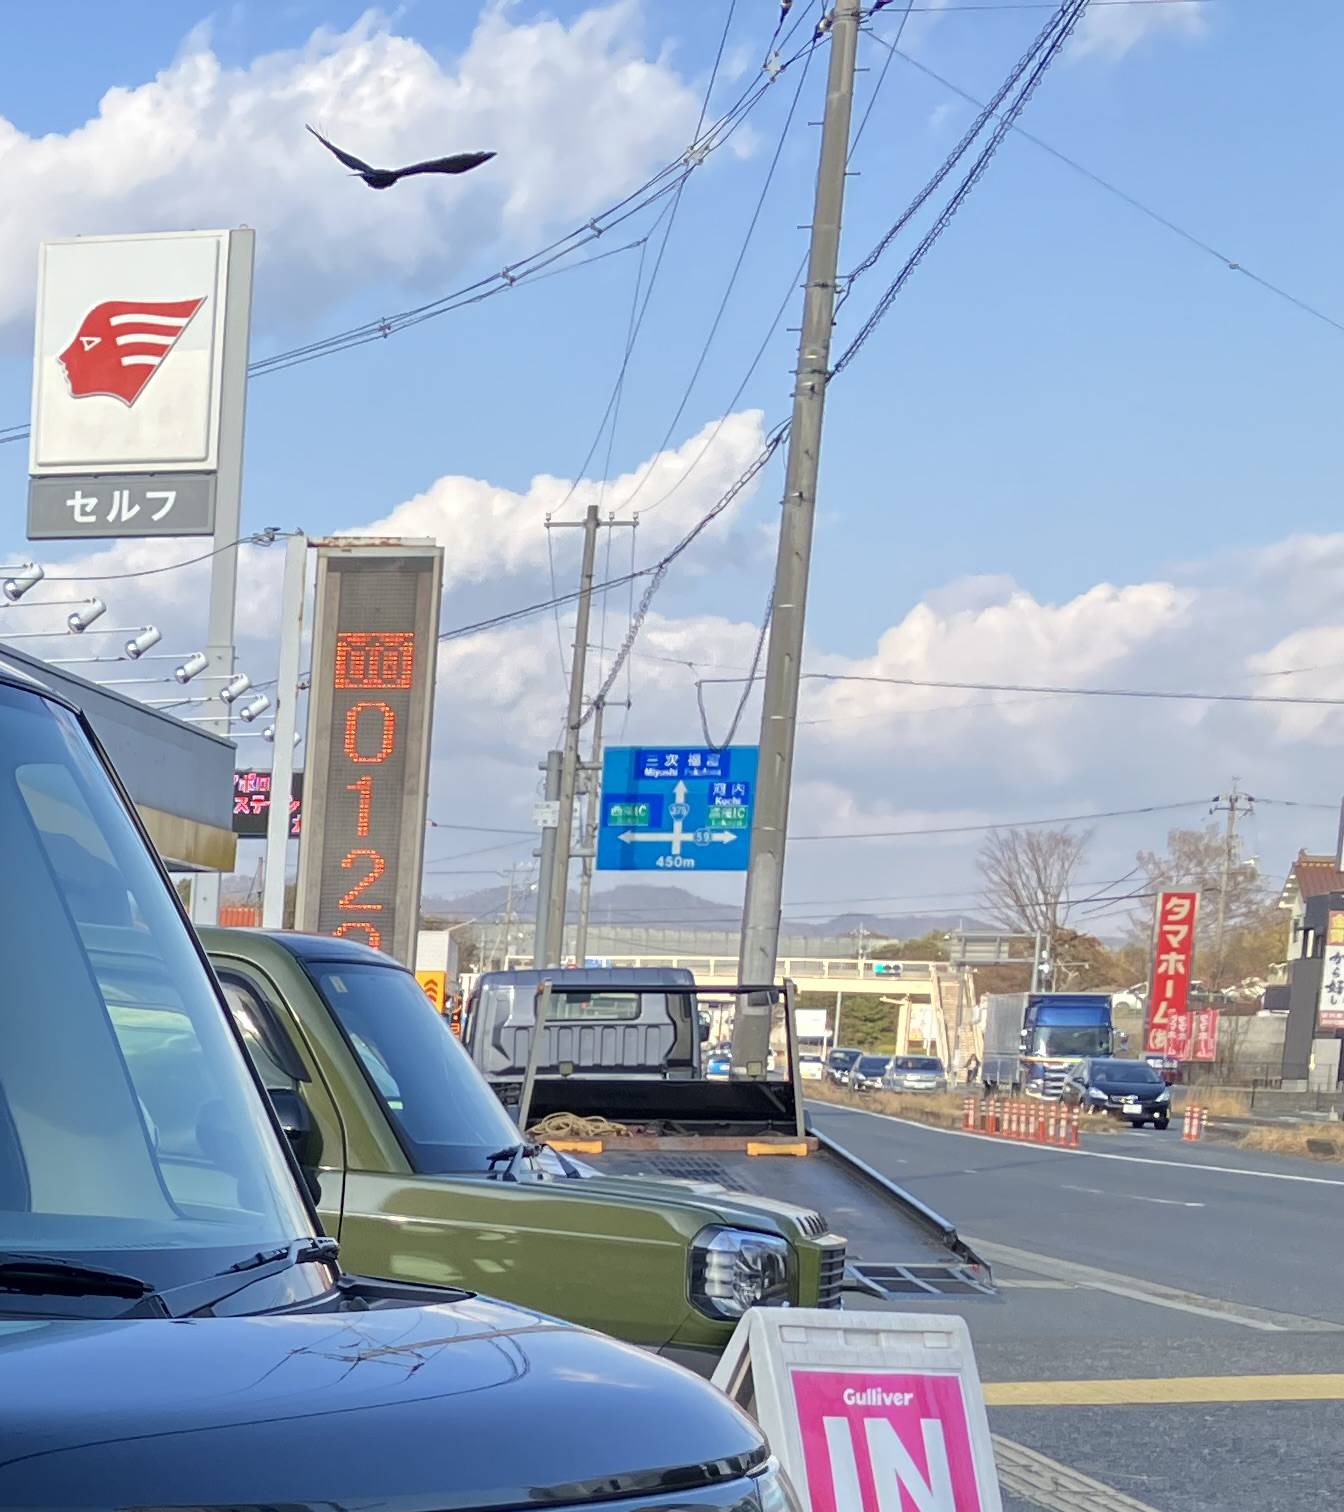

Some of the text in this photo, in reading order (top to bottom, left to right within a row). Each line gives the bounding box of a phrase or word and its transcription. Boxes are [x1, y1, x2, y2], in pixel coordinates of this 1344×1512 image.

[66, 489, 177, 522] セルフ
[656, 856, 695, 869] 450m
[843, 1387, 914, 1406] Gulliver
